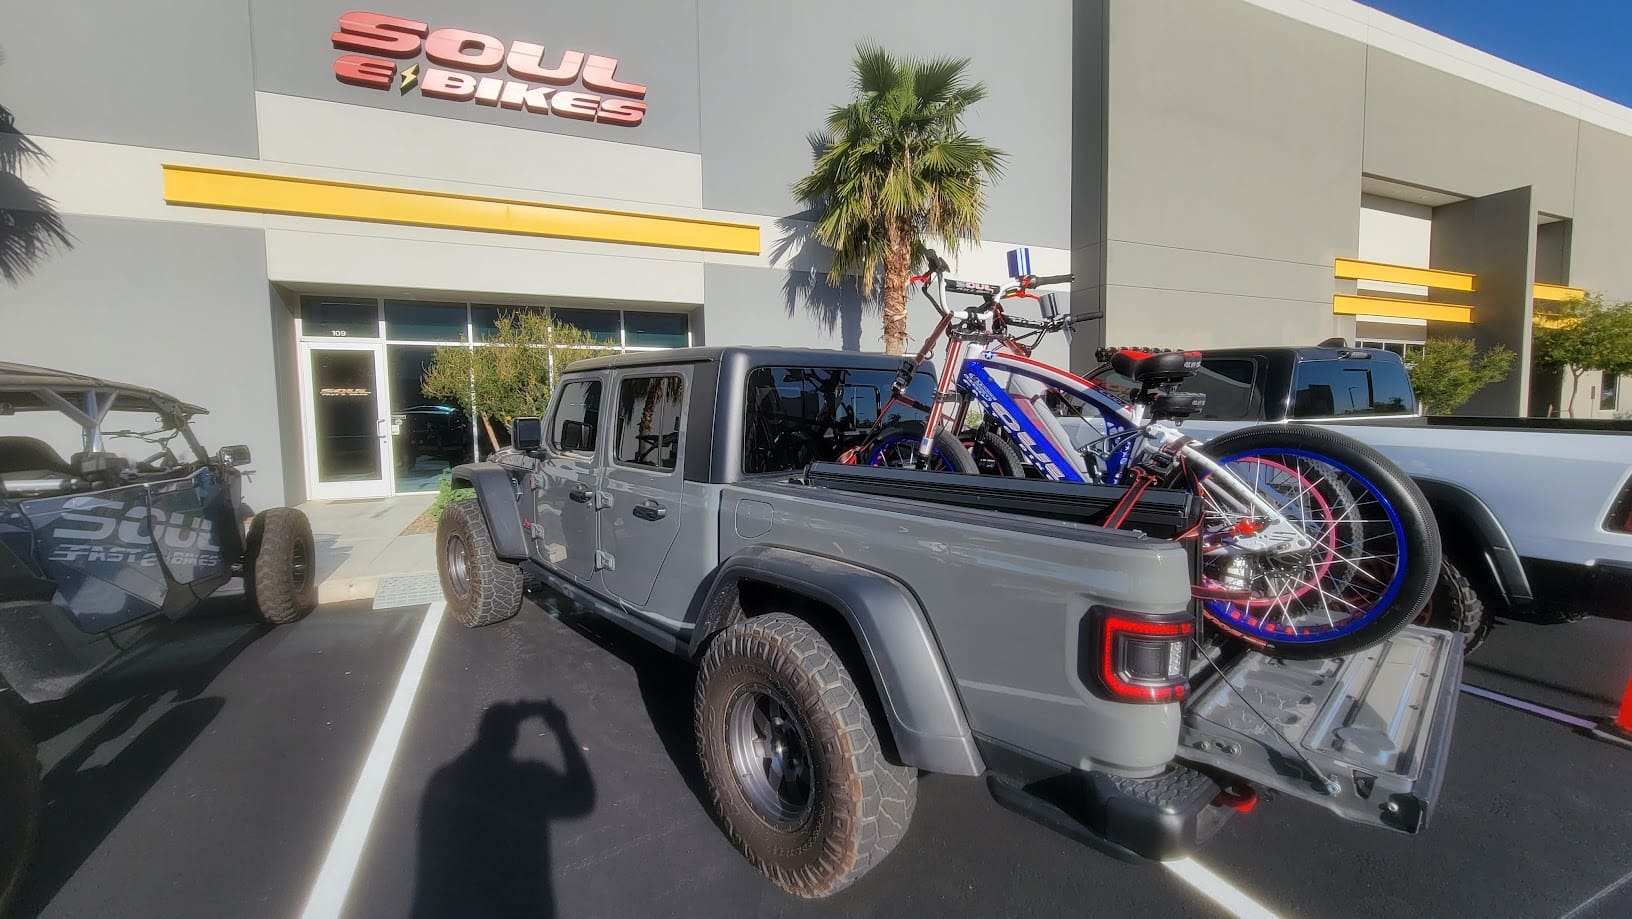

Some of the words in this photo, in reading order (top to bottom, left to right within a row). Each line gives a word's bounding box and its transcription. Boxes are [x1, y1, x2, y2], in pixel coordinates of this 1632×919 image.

[331, 11, 648, 99] SOUL
[421, 68, 648, 127] BIKES
[53, 496, 220, 552] SOUL
